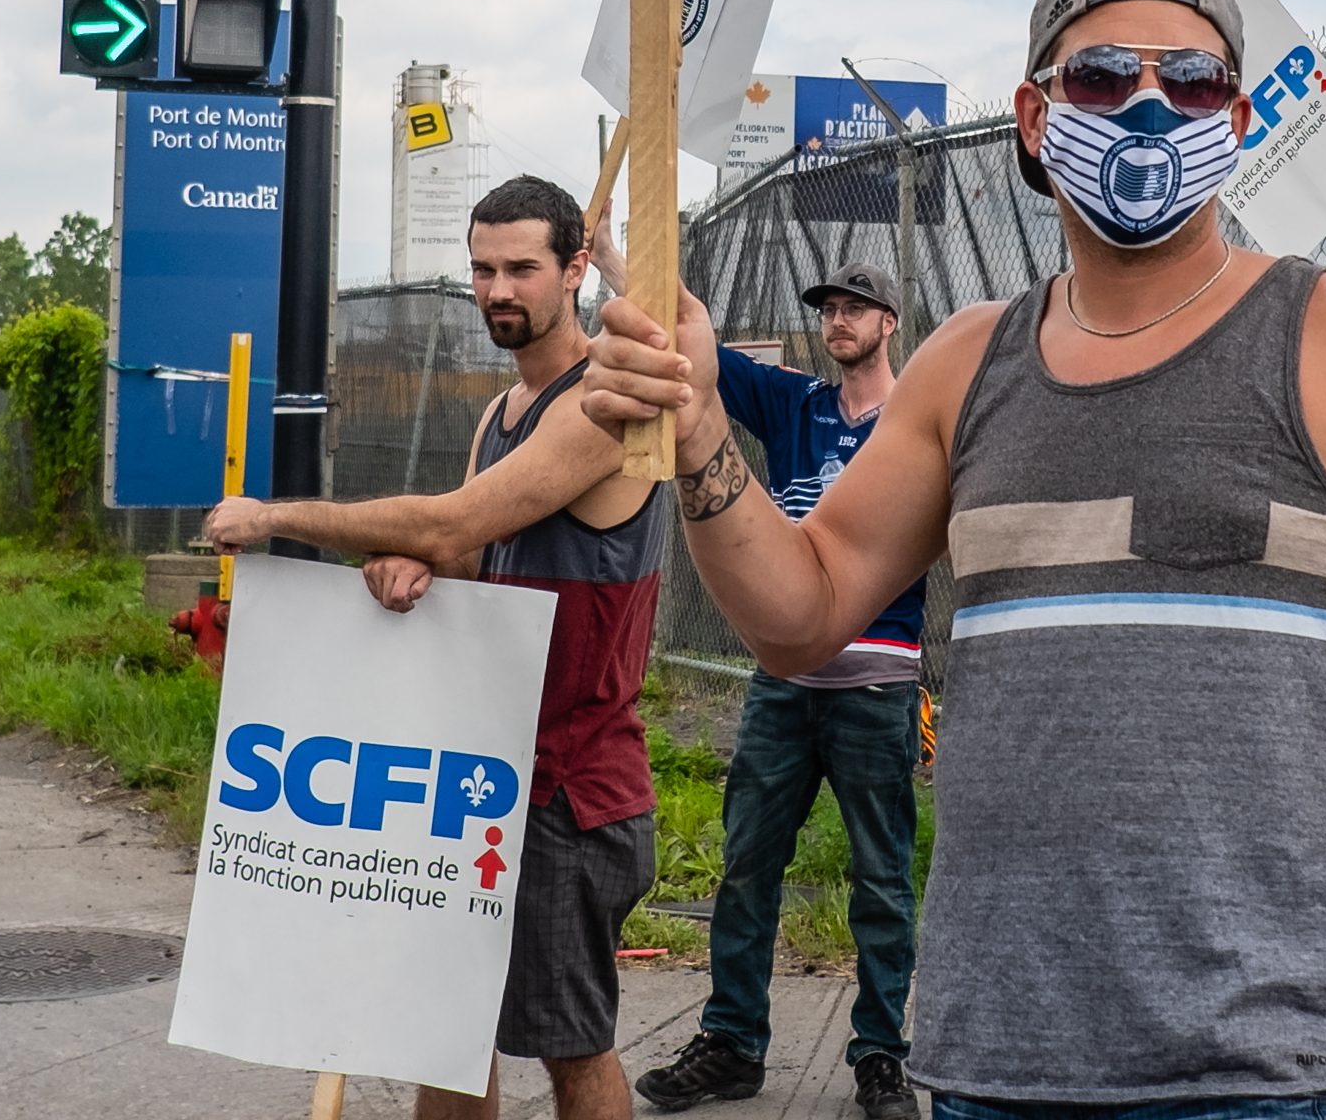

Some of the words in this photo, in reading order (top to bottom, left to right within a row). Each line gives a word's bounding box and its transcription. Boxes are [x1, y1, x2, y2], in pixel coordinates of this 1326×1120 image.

[149, 105, 190, 125] Port
[195, 105, 222, 126] de
[227, 108, 286, 129] Montr
[410, 113, 437, 137] B
[735, 124, 785, 133] ÉLIORATION
[153, 130, 193, 149] Port
[199, 130, 219, 150] of
[224, 132, 285, 152] Montr
[732, 135, 741, 143] ES
[744, 135, 769, 144] PORTS
[1224, 158, 1266, 202] Syndicat
[1265, 114, 1309, 160] canadien
[1307, 99, 1322, 116] de
[182, 183, 279, 211] Canada
[1233, 199, 1245, 211] la
[1243, 157, 1286, 201] fonction
[218, 722, 519, 840] SCFP
[211, 823, 297, 863] Syndicat
[302, 848, 419, 879] canadien
[427, 855, 459, 882] de
[208, 851, 226, 876] la
[233, 856, 323, 896] fonction
[329, 878, 447, 911] publique
[468, 896, 504, 920] FTQ
